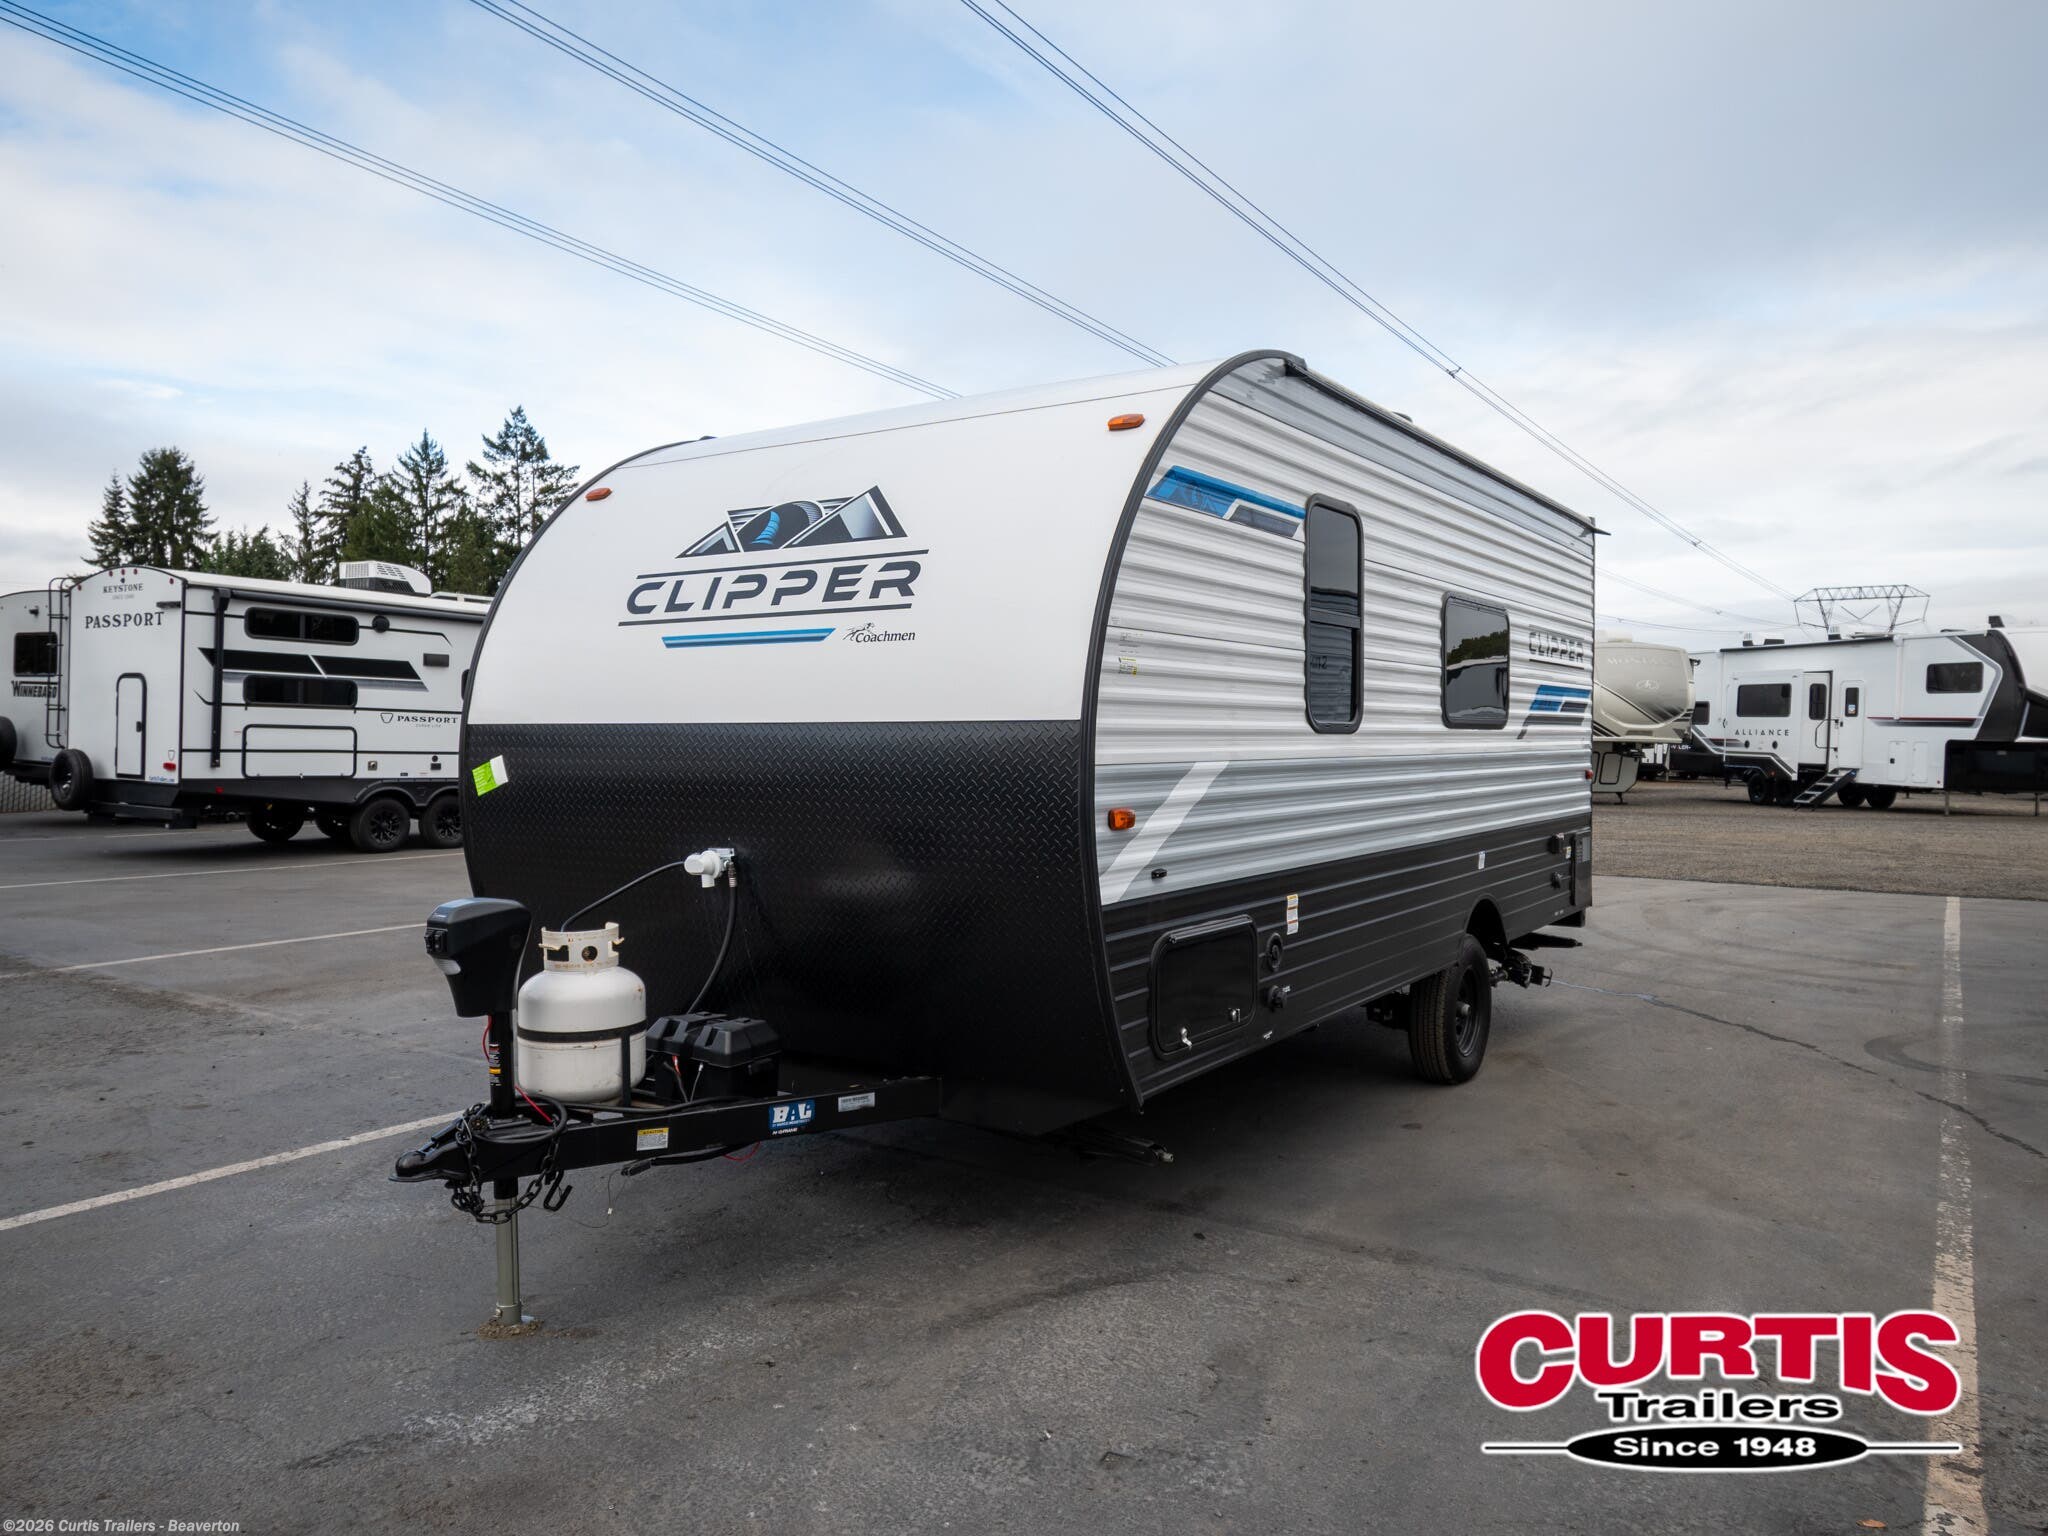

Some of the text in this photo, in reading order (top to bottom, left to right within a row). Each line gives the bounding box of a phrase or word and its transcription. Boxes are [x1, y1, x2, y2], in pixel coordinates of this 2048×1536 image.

[103, 583, 144, 593] KEYSTONE
[626, 560, 922, 615] CLIPPER
[85, 611, 165, 629] PASSPORT
[855, 629, 916, 643] Coachmen
[1528, 631, 1584, 662] CLIPPER
[397, 715, 458, 724] PASSPORT
